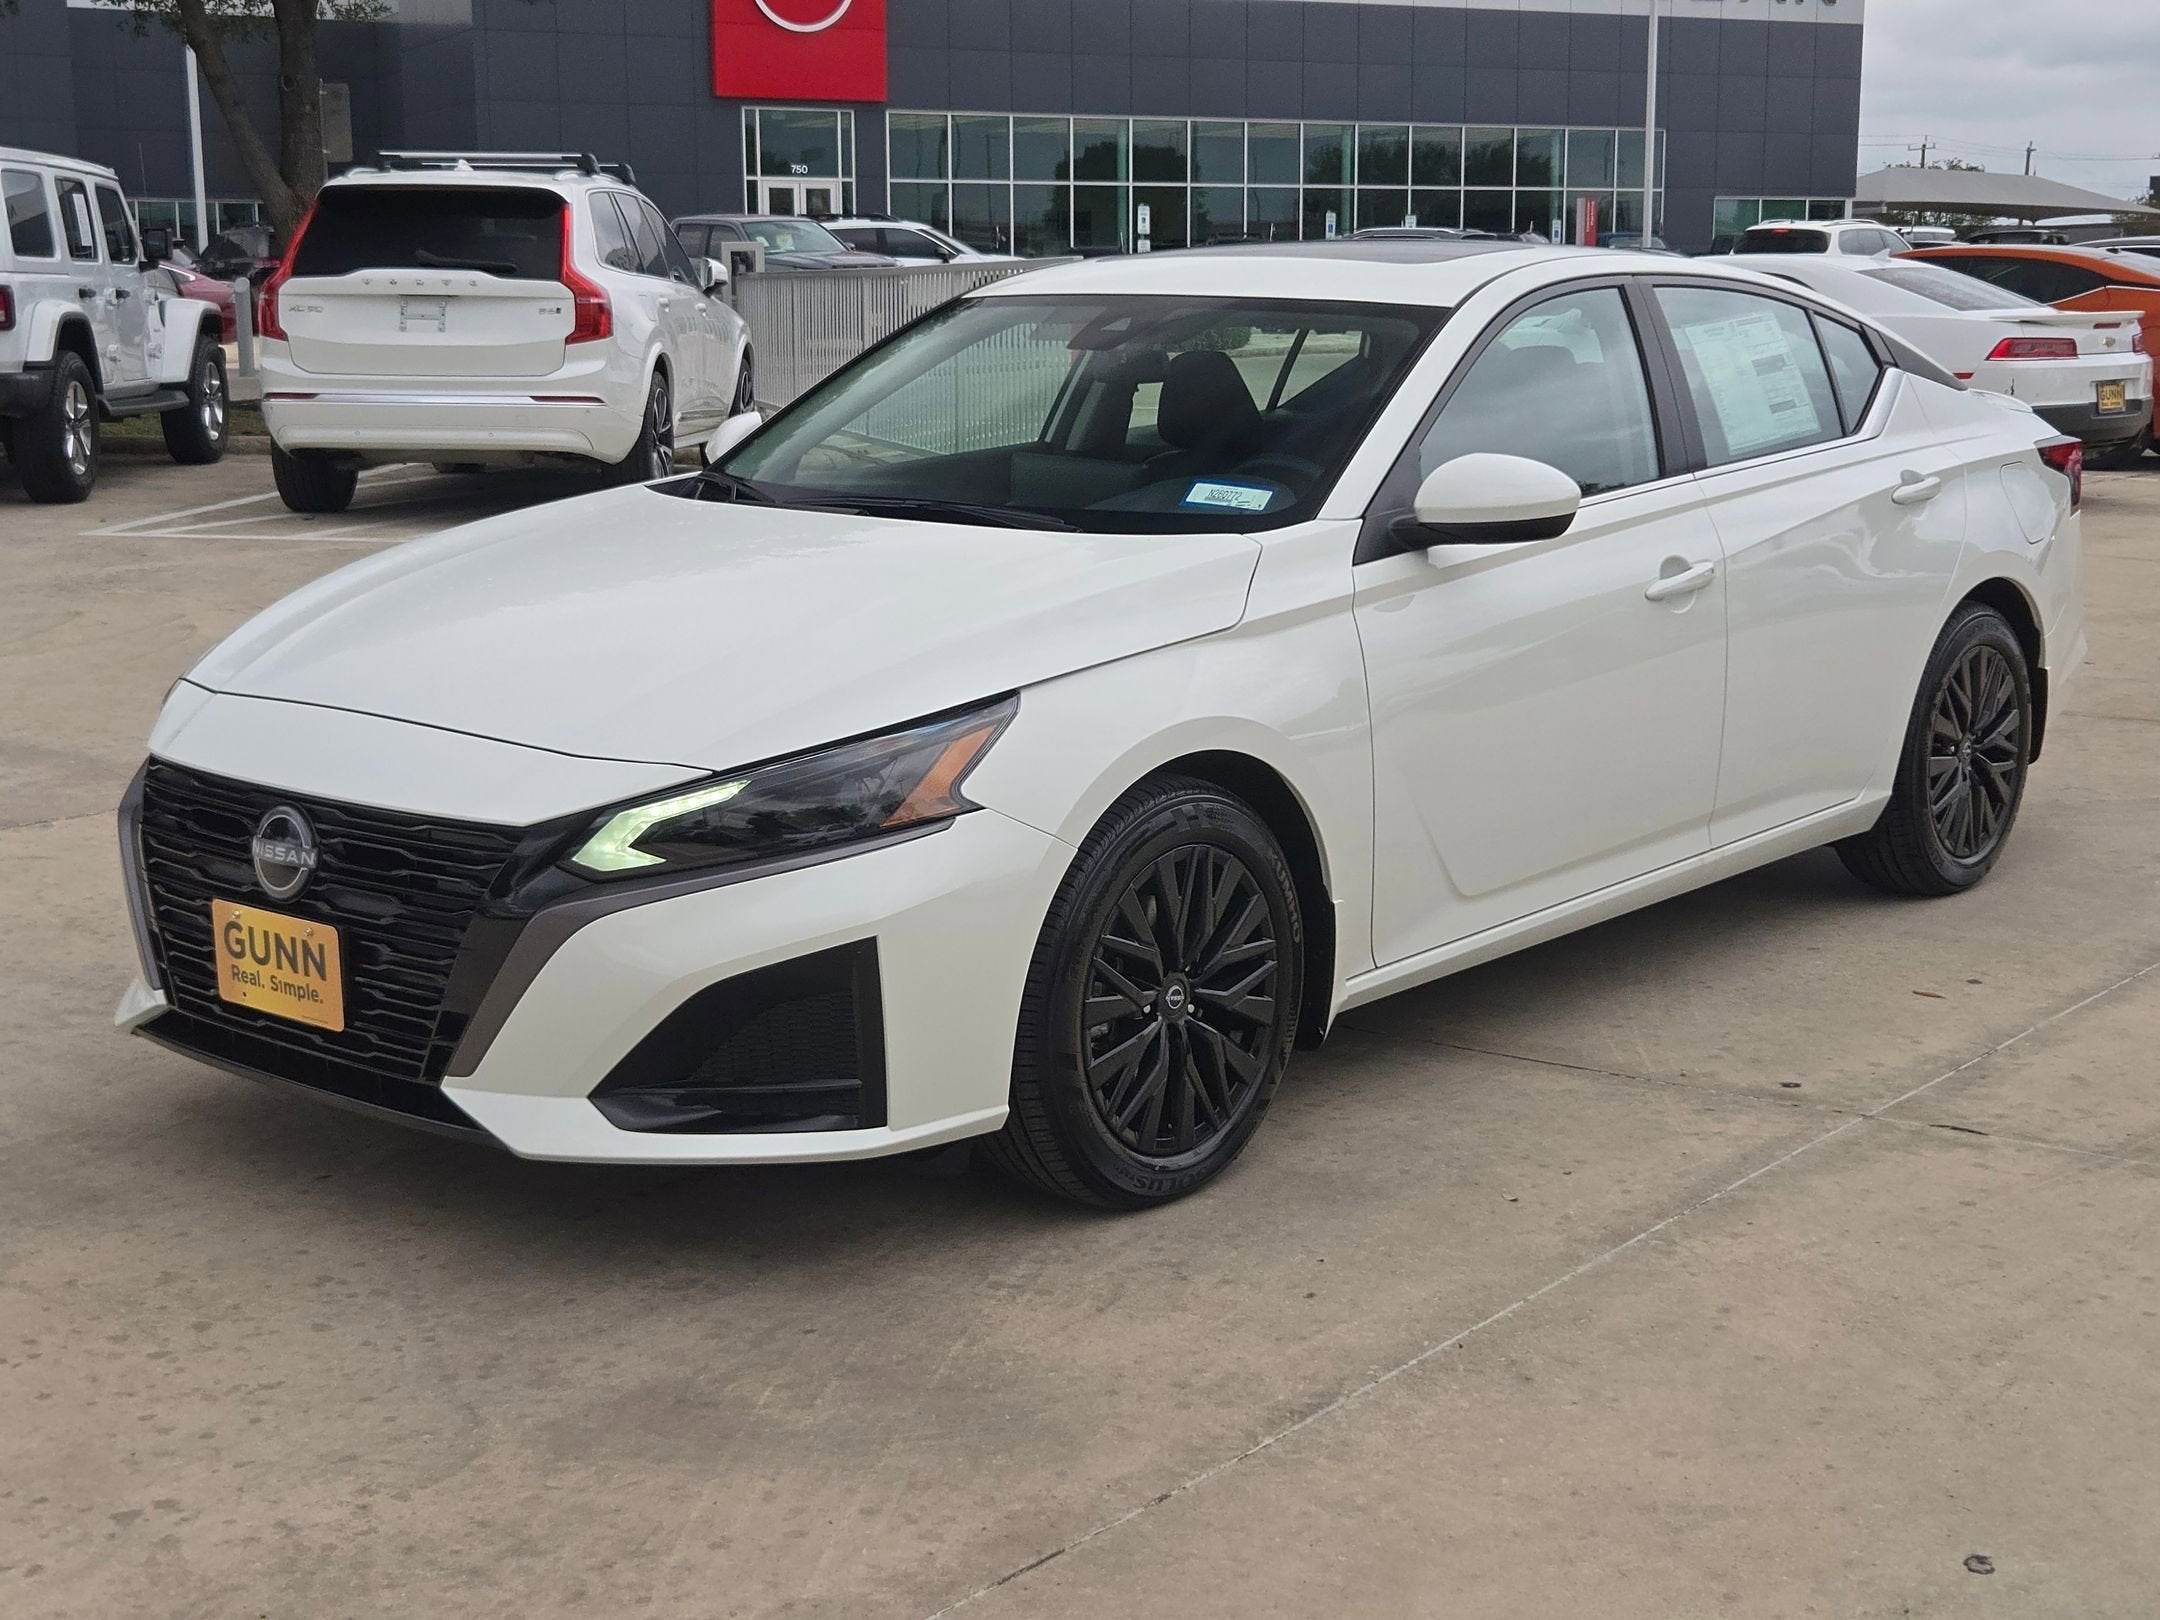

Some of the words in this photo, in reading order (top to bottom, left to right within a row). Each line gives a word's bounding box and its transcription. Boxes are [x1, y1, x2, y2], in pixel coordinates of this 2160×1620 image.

[790, 164, 808, 174] 750
[2101, 388, 2122, 401] GUNN
[253, 841, 315, 866] NISSAN
[223, 920, 327, 982] GUNN
[231, 964, 265, 989] Real.
